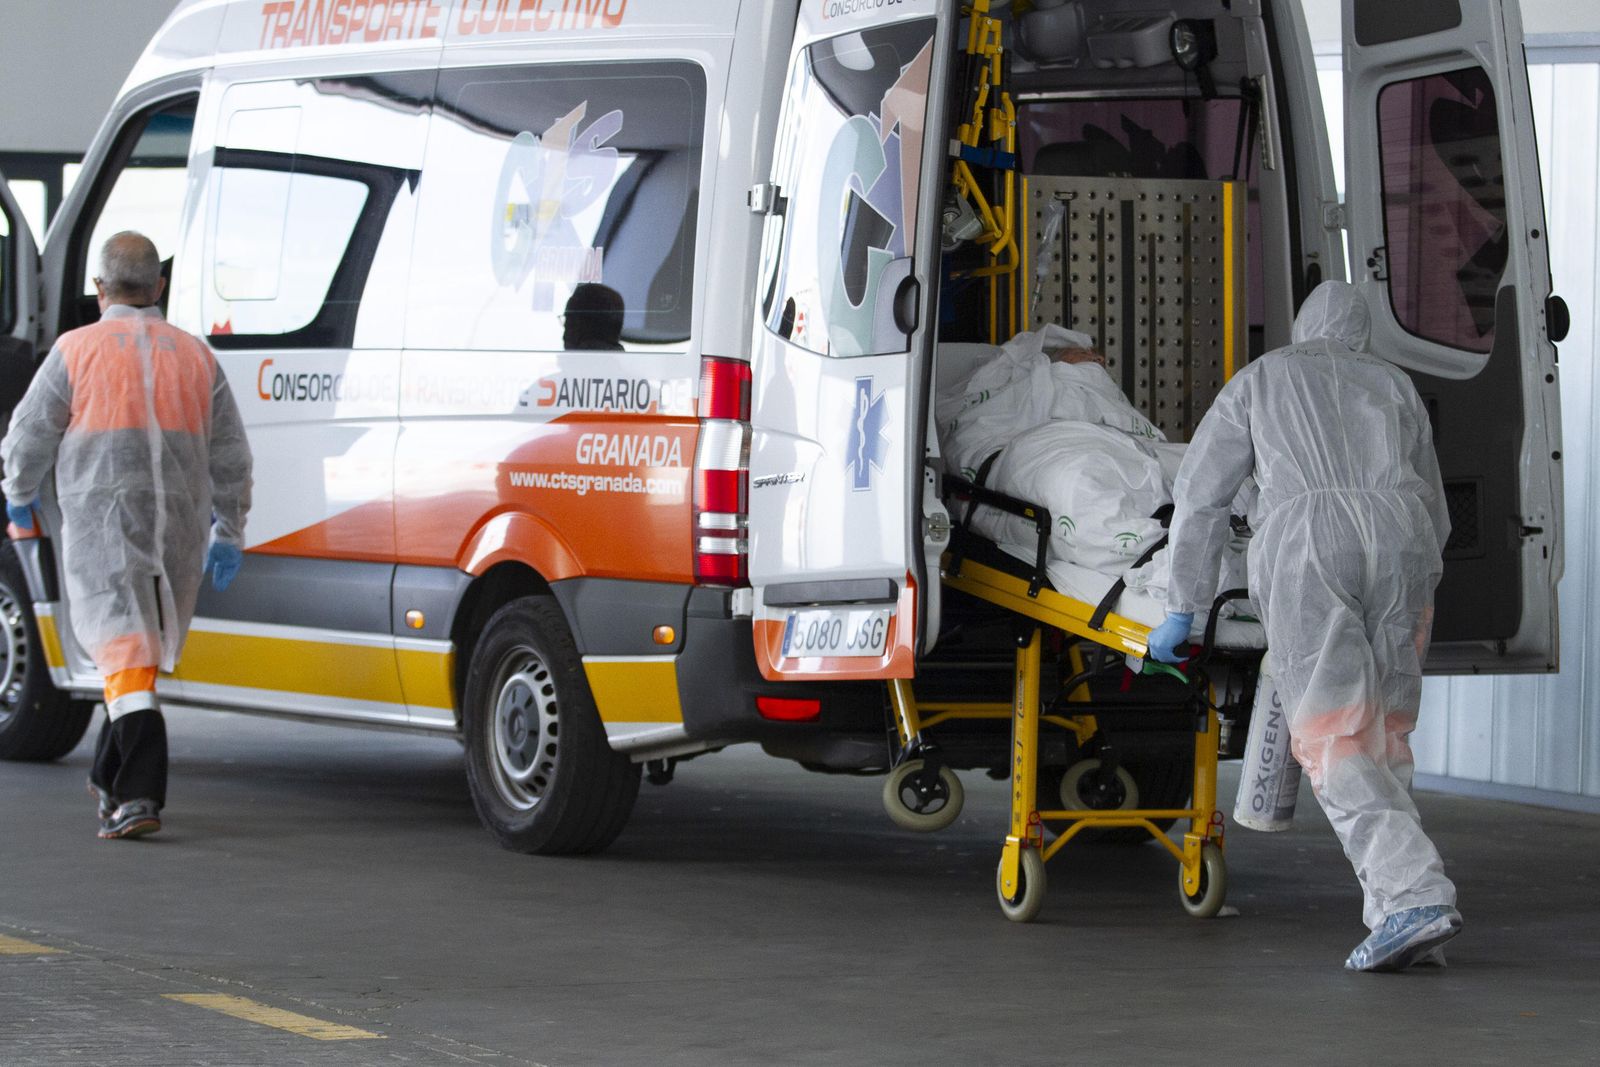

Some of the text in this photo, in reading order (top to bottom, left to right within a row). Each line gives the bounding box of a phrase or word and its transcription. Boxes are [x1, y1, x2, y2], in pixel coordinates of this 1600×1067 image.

[259, 0, 628, 50] TRANSPORTE COLECTIVO
[536, 376, 650, 411] SANITARIO
[575, 432, 683, 467] GRANADA
[509, 470, 684, 496] www.ctsgranada.com
[793, 617, 884, 650] 5080 JSG
